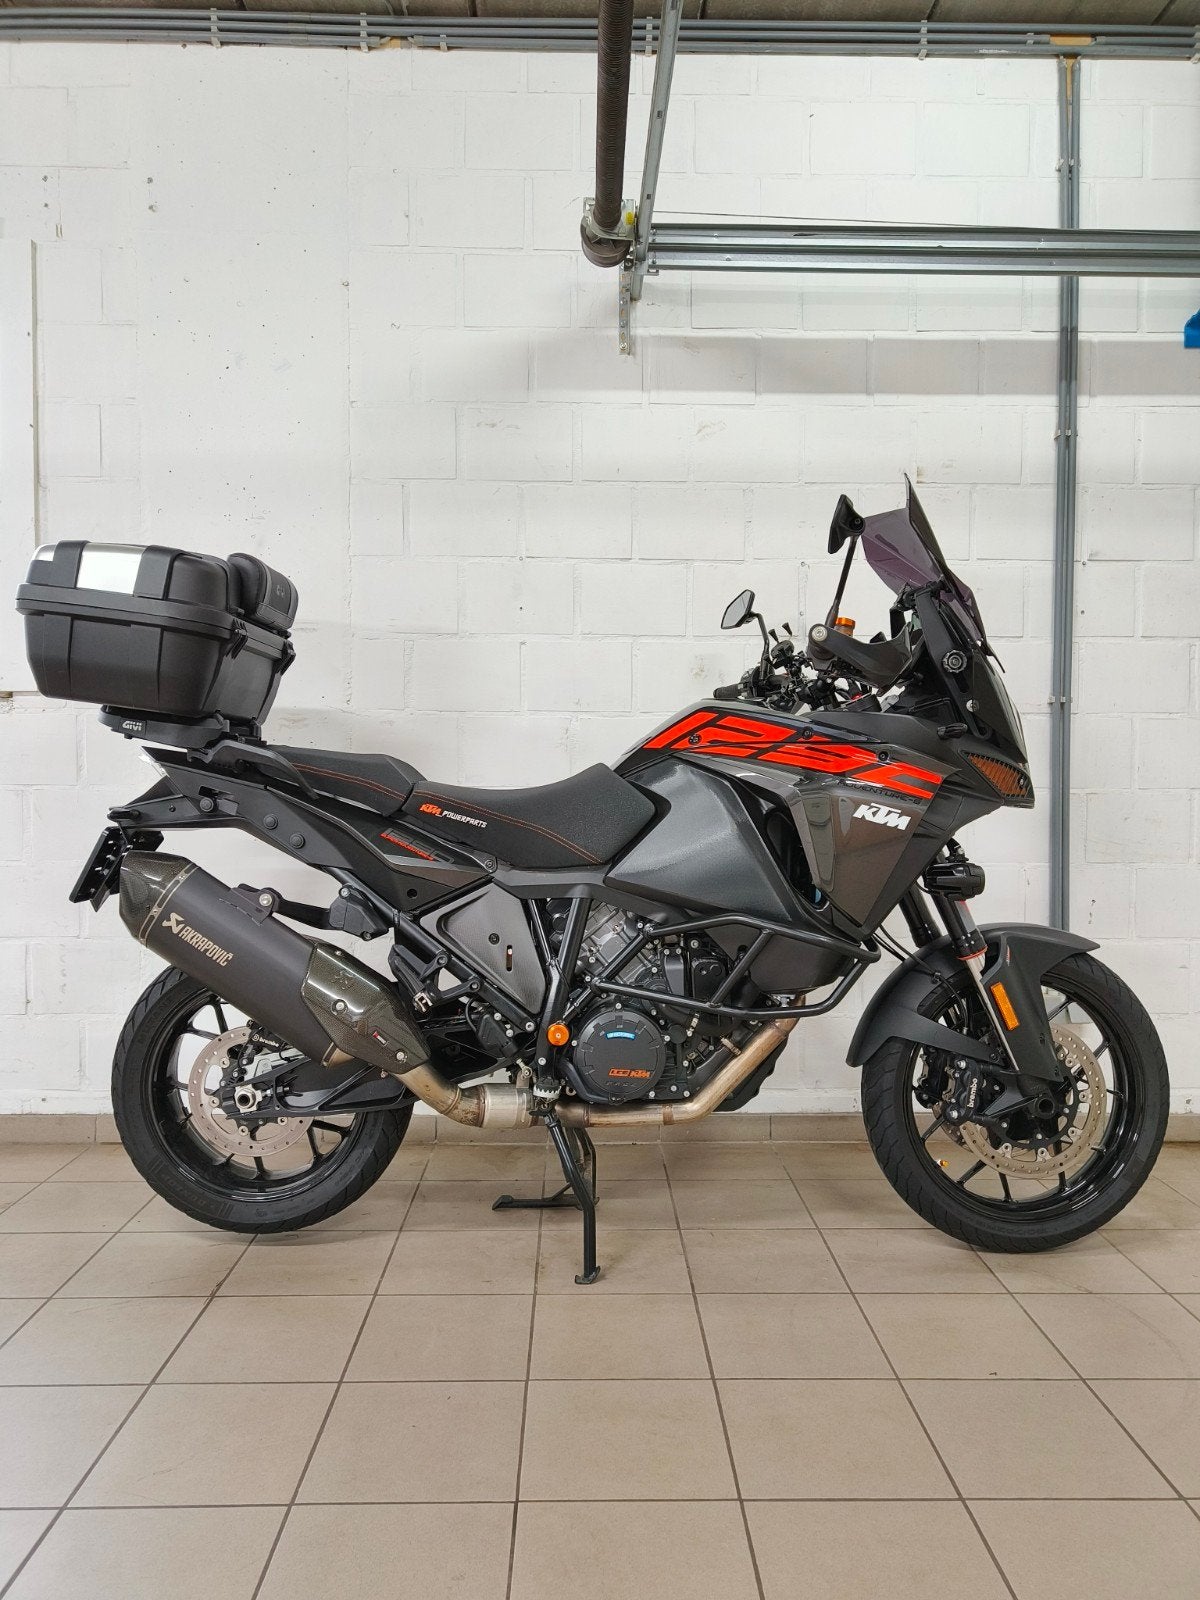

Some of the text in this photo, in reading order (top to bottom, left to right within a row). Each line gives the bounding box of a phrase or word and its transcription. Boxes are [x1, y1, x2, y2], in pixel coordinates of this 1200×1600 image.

[419, 803, 488, 828] KTM POWERPARTS
[852, 802, 912, 831] KTM
[967, 1078, 978, 1107] brembo
